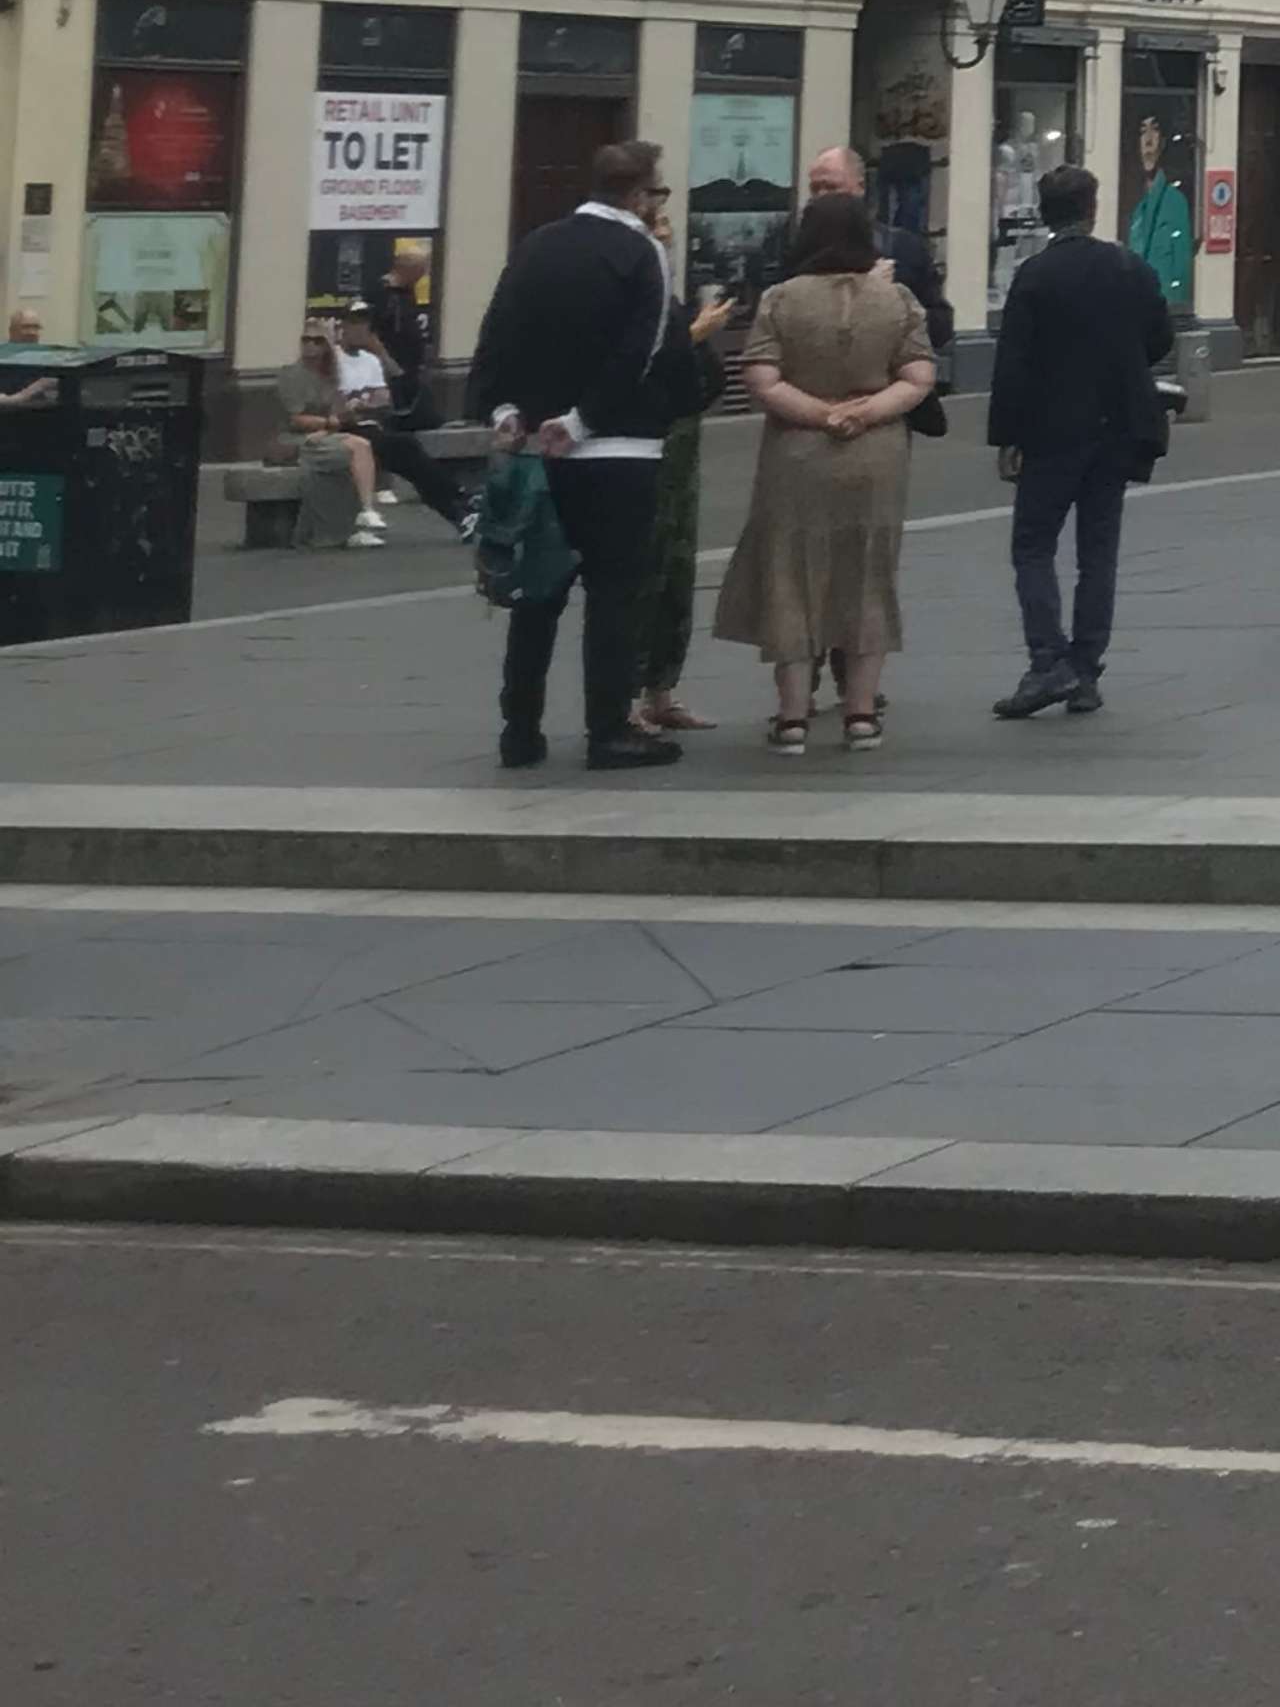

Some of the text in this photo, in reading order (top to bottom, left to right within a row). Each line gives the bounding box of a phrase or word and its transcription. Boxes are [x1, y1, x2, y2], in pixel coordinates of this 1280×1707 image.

[324, 99, 432, 124] RETAIL UNIT
[323, 130, 430, 171] TO LET
